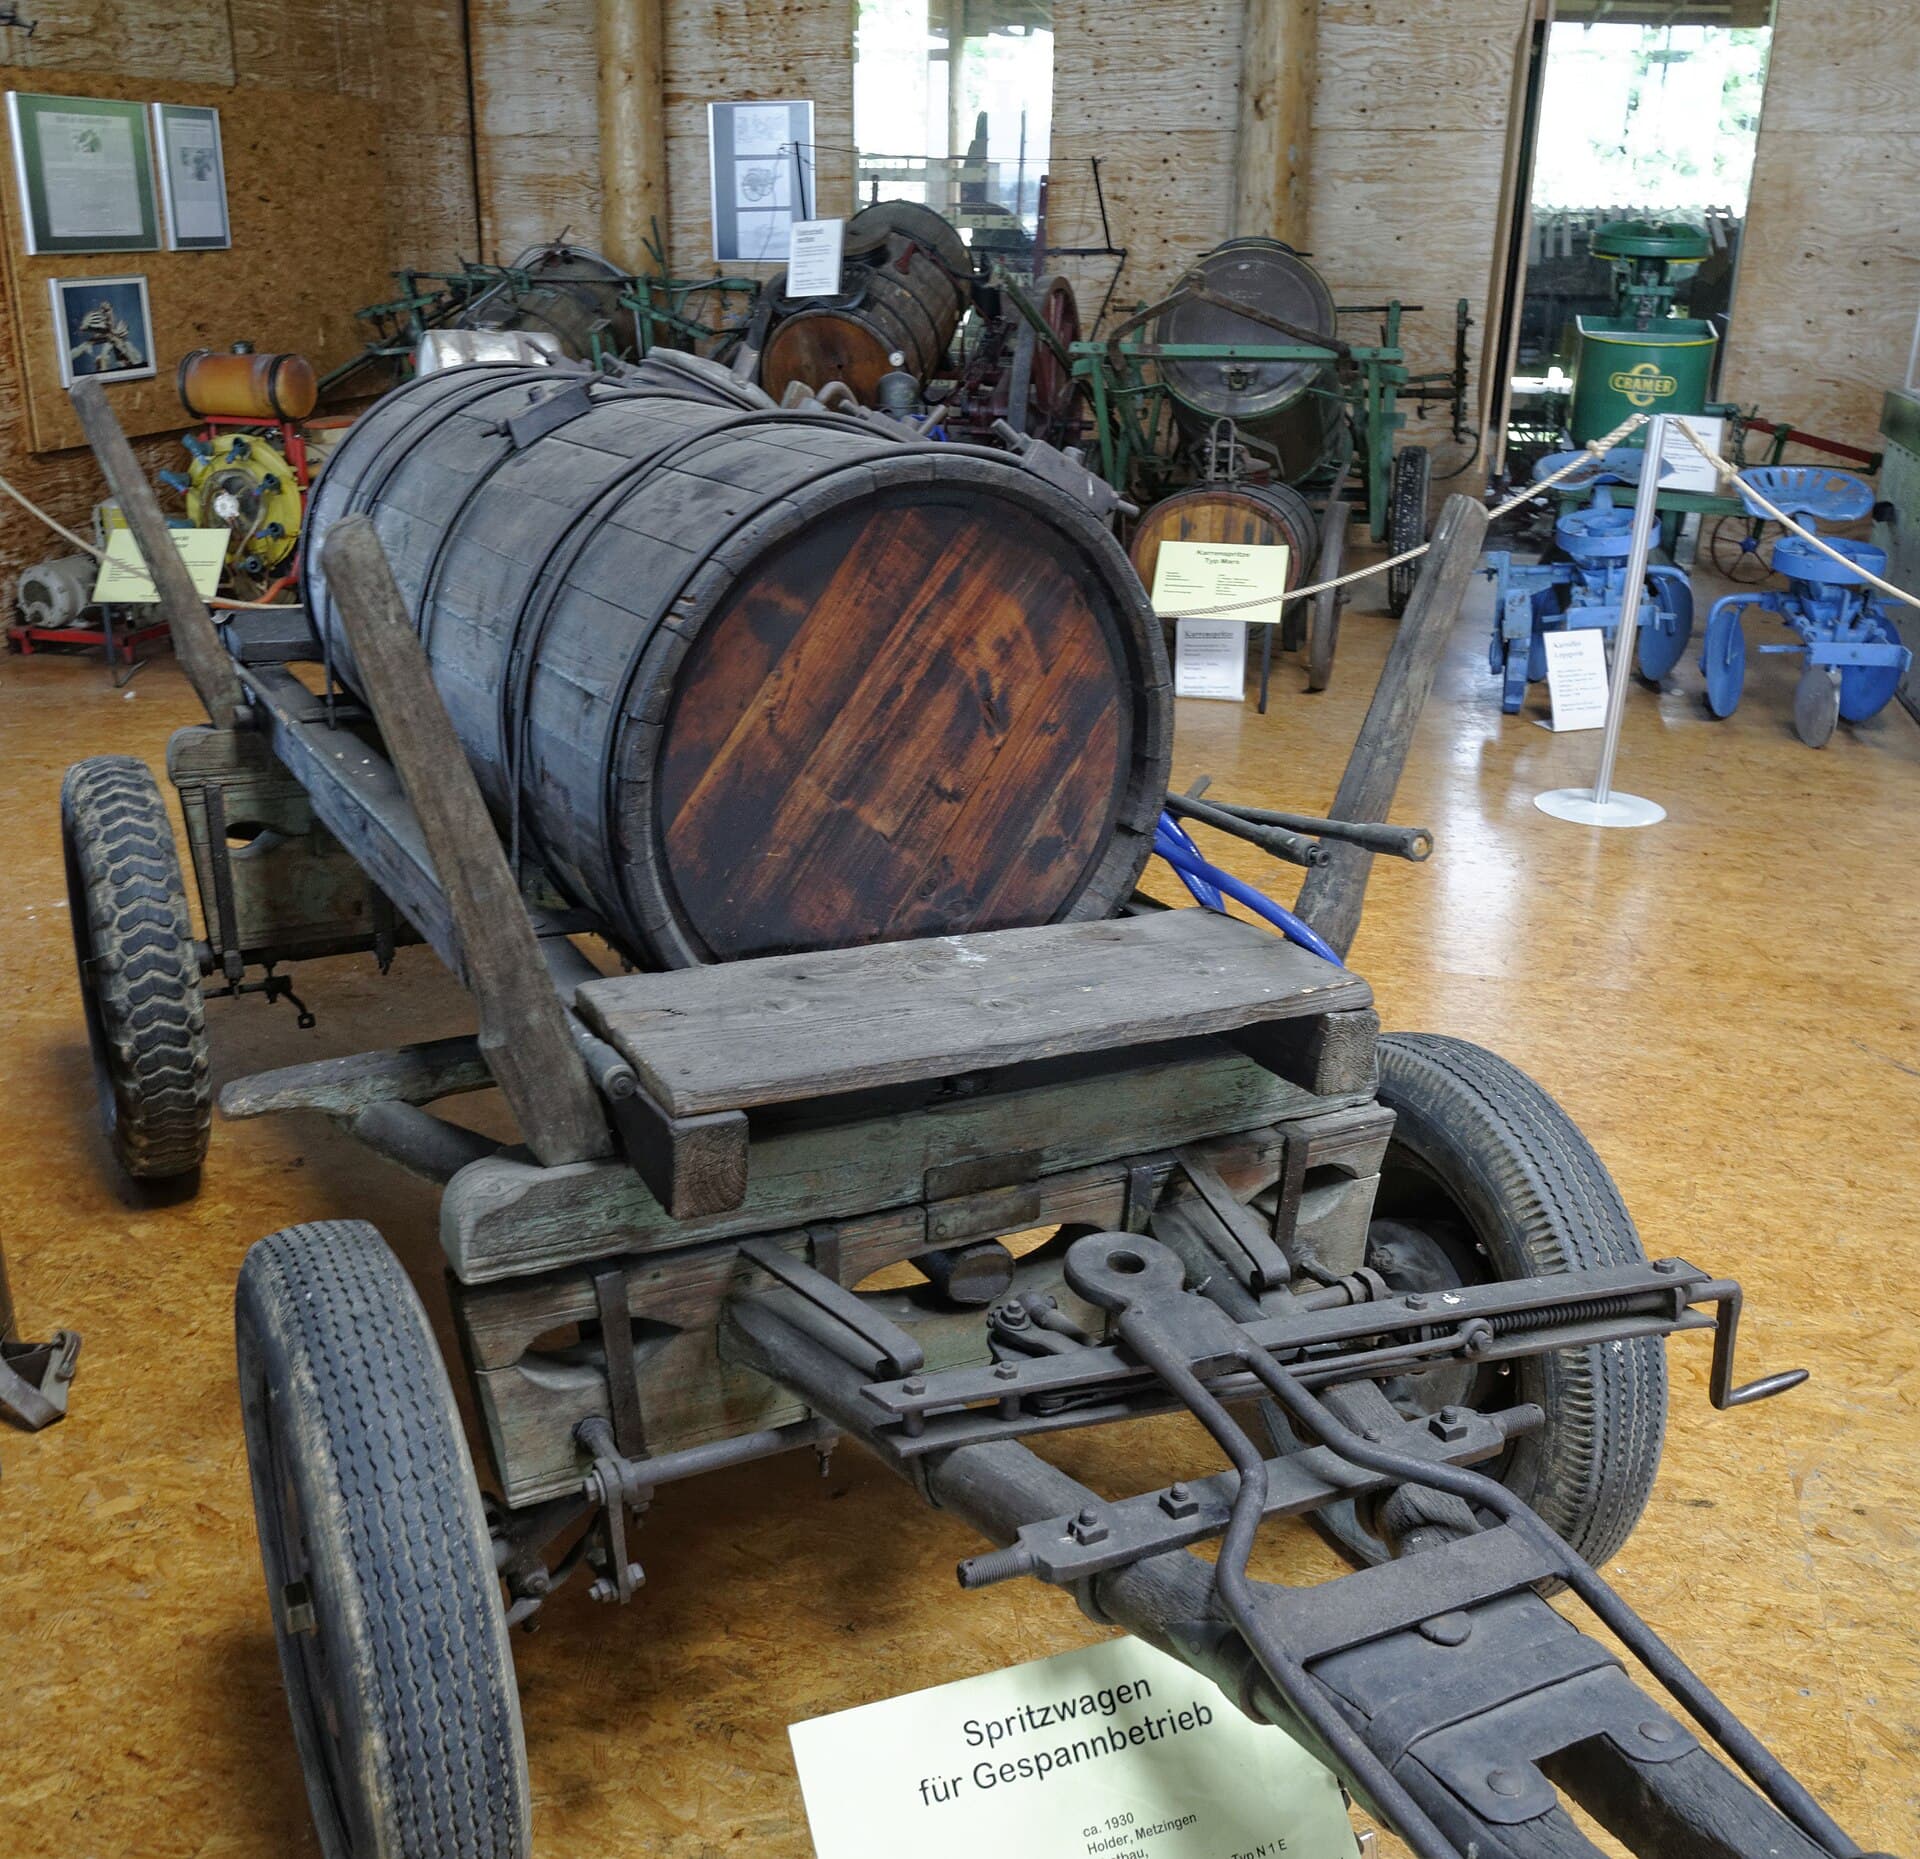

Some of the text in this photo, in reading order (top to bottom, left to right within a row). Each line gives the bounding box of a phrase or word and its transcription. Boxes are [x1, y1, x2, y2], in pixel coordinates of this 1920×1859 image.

[1614, 376, 1673, 393] CRAMER
[962, 1678, 1152, 1748] Spritzwagen
[918, 1701, 1213, 1807] für Gespannbetrieb
[1083, 1812, 1135, 1838] ca. 1930
[1086, 1813, 1198, 1855] Holder, Metzingen
[1255, 1845, 1267, 1858] N
[1268, 1842, 1275, 1854] 1
[1277, 1838, 1288, 1851] E
